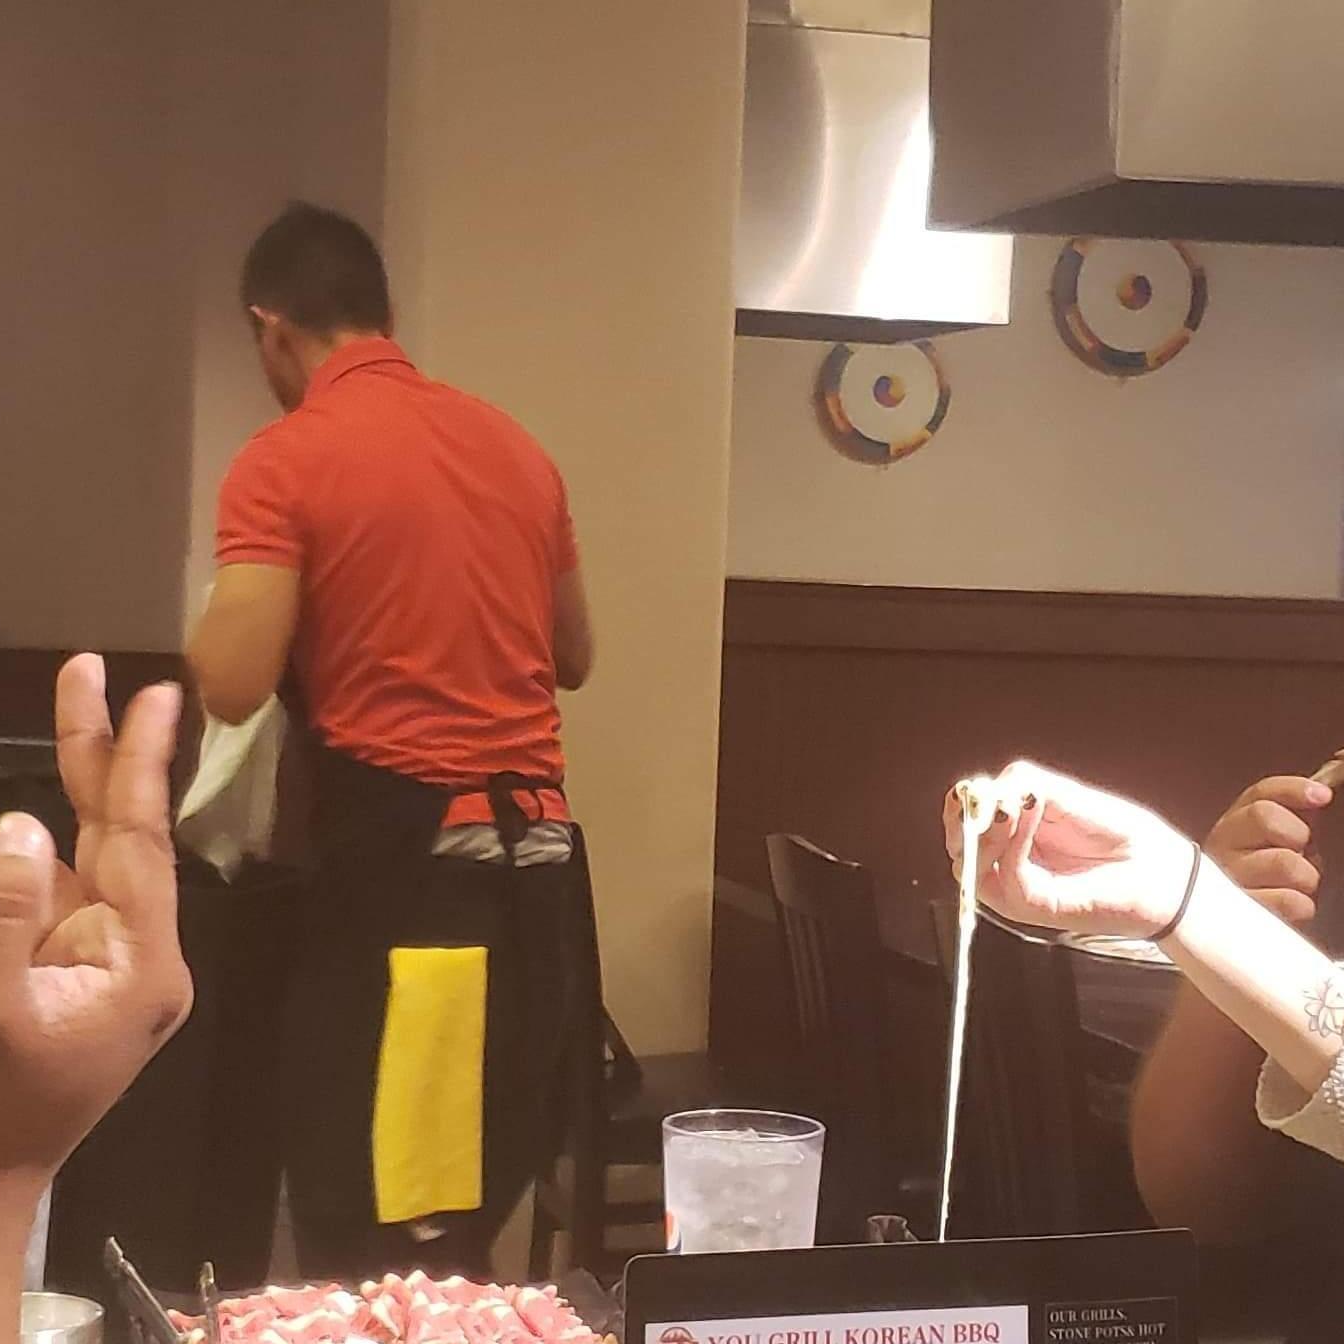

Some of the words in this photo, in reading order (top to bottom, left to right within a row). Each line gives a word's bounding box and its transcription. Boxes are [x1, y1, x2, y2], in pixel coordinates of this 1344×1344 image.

[1049, 1309, 1077, 1323] OUR
[953, 1321, 1001, 1344] BBQ
[1049, 1327, 1091, 1340] STONE
[1138, 1323, 1166, 1336] HOT
